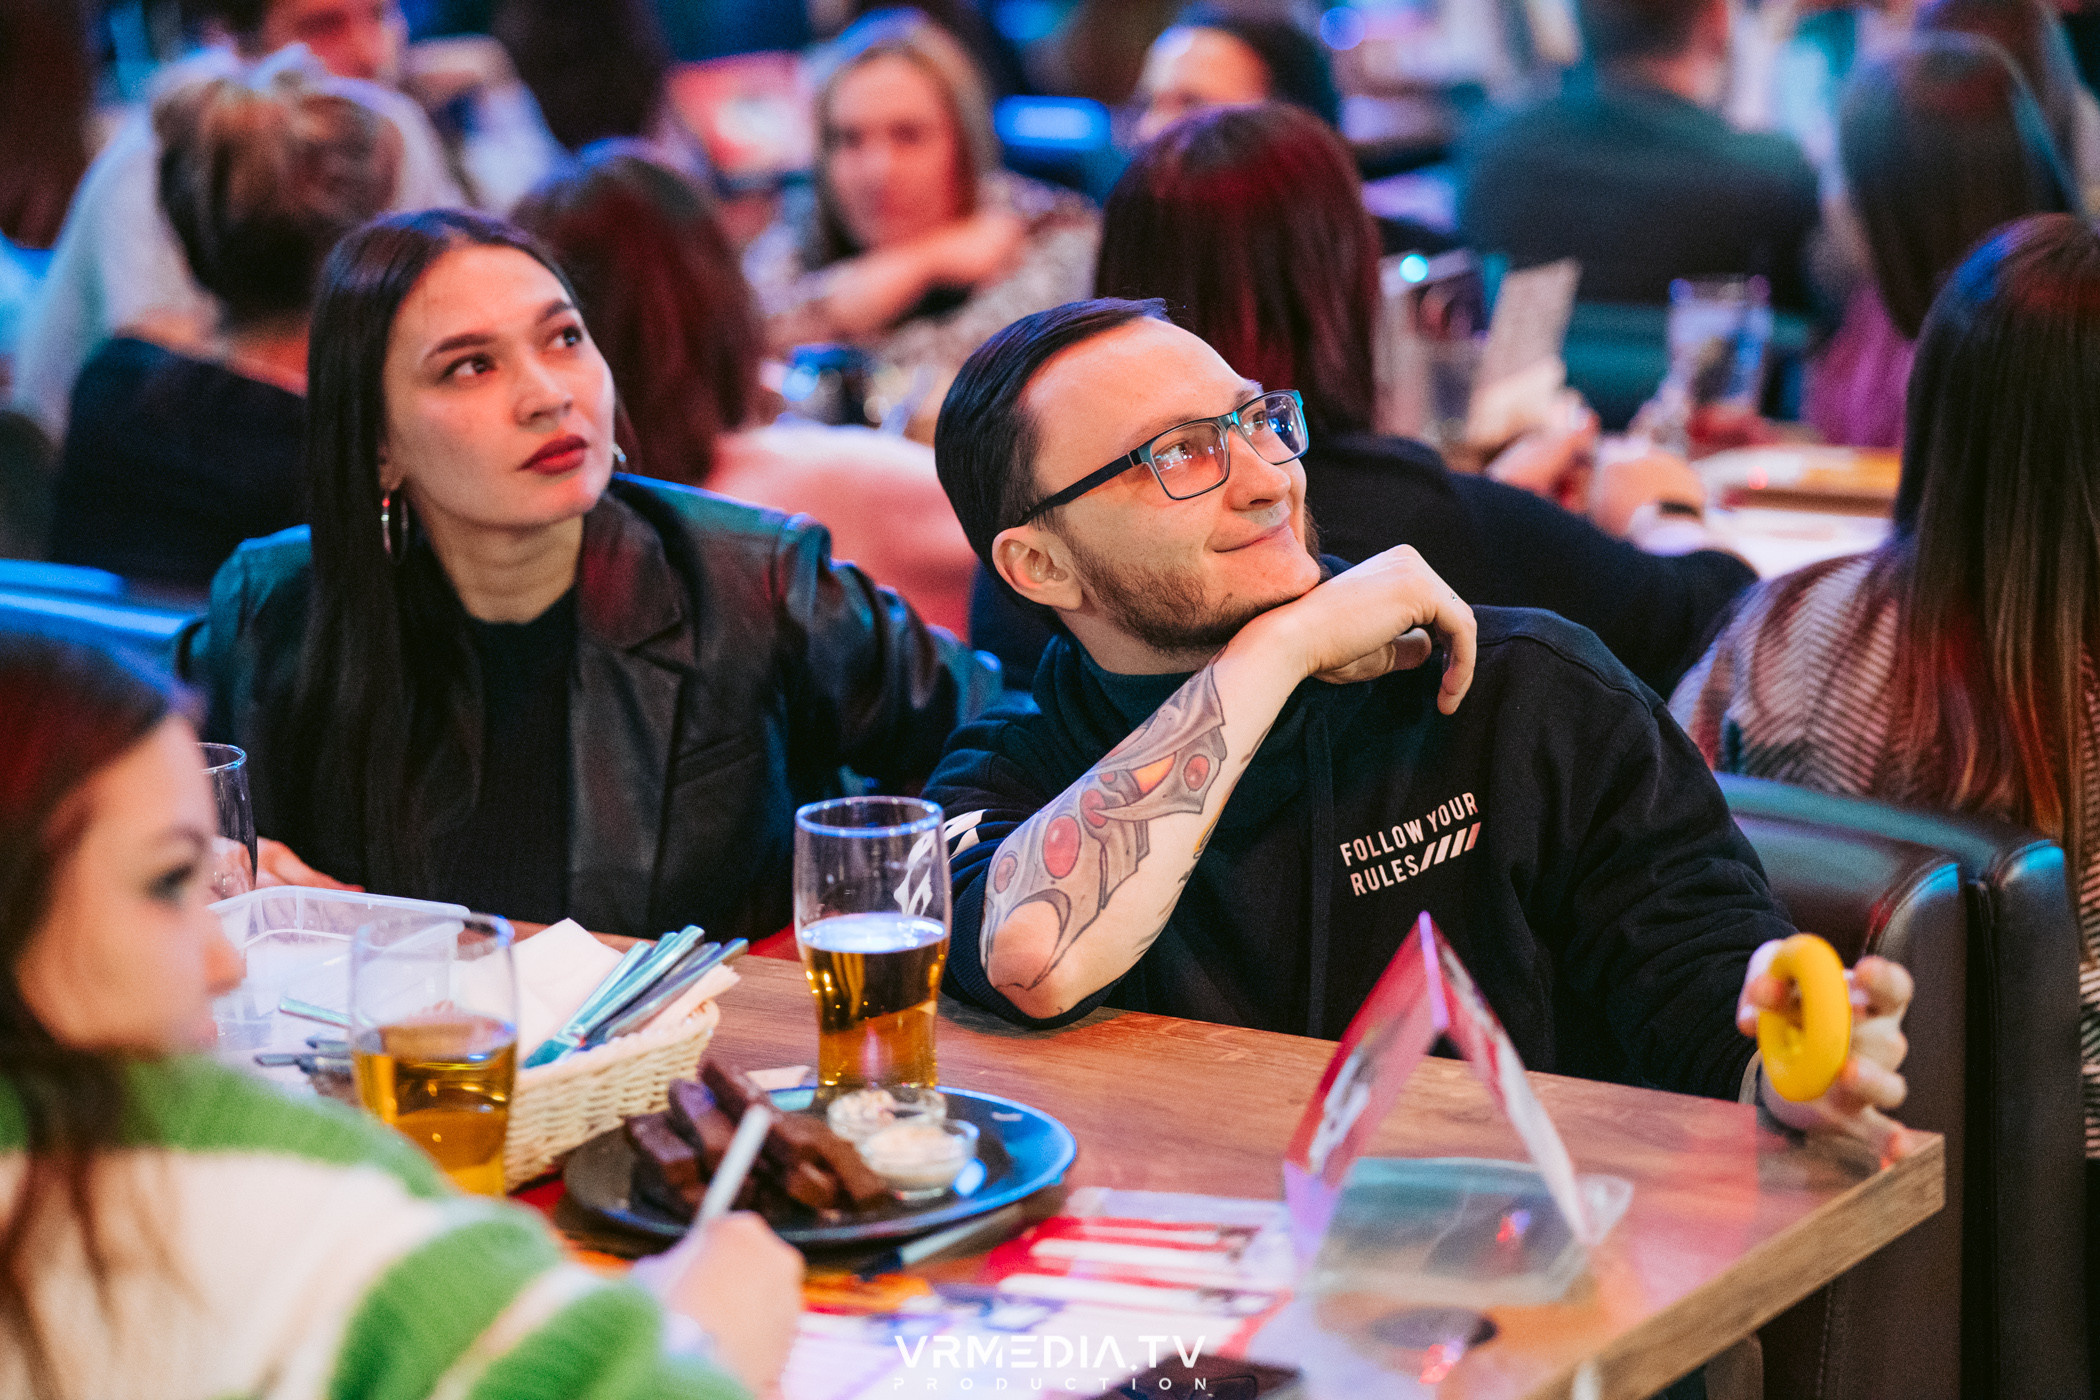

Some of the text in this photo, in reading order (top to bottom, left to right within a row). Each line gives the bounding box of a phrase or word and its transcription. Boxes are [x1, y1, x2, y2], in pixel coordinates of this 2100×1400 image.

[1340, 792, 1478, 867] FOLLOW YOUR
[1350, 854, 1420, 896] RULES
